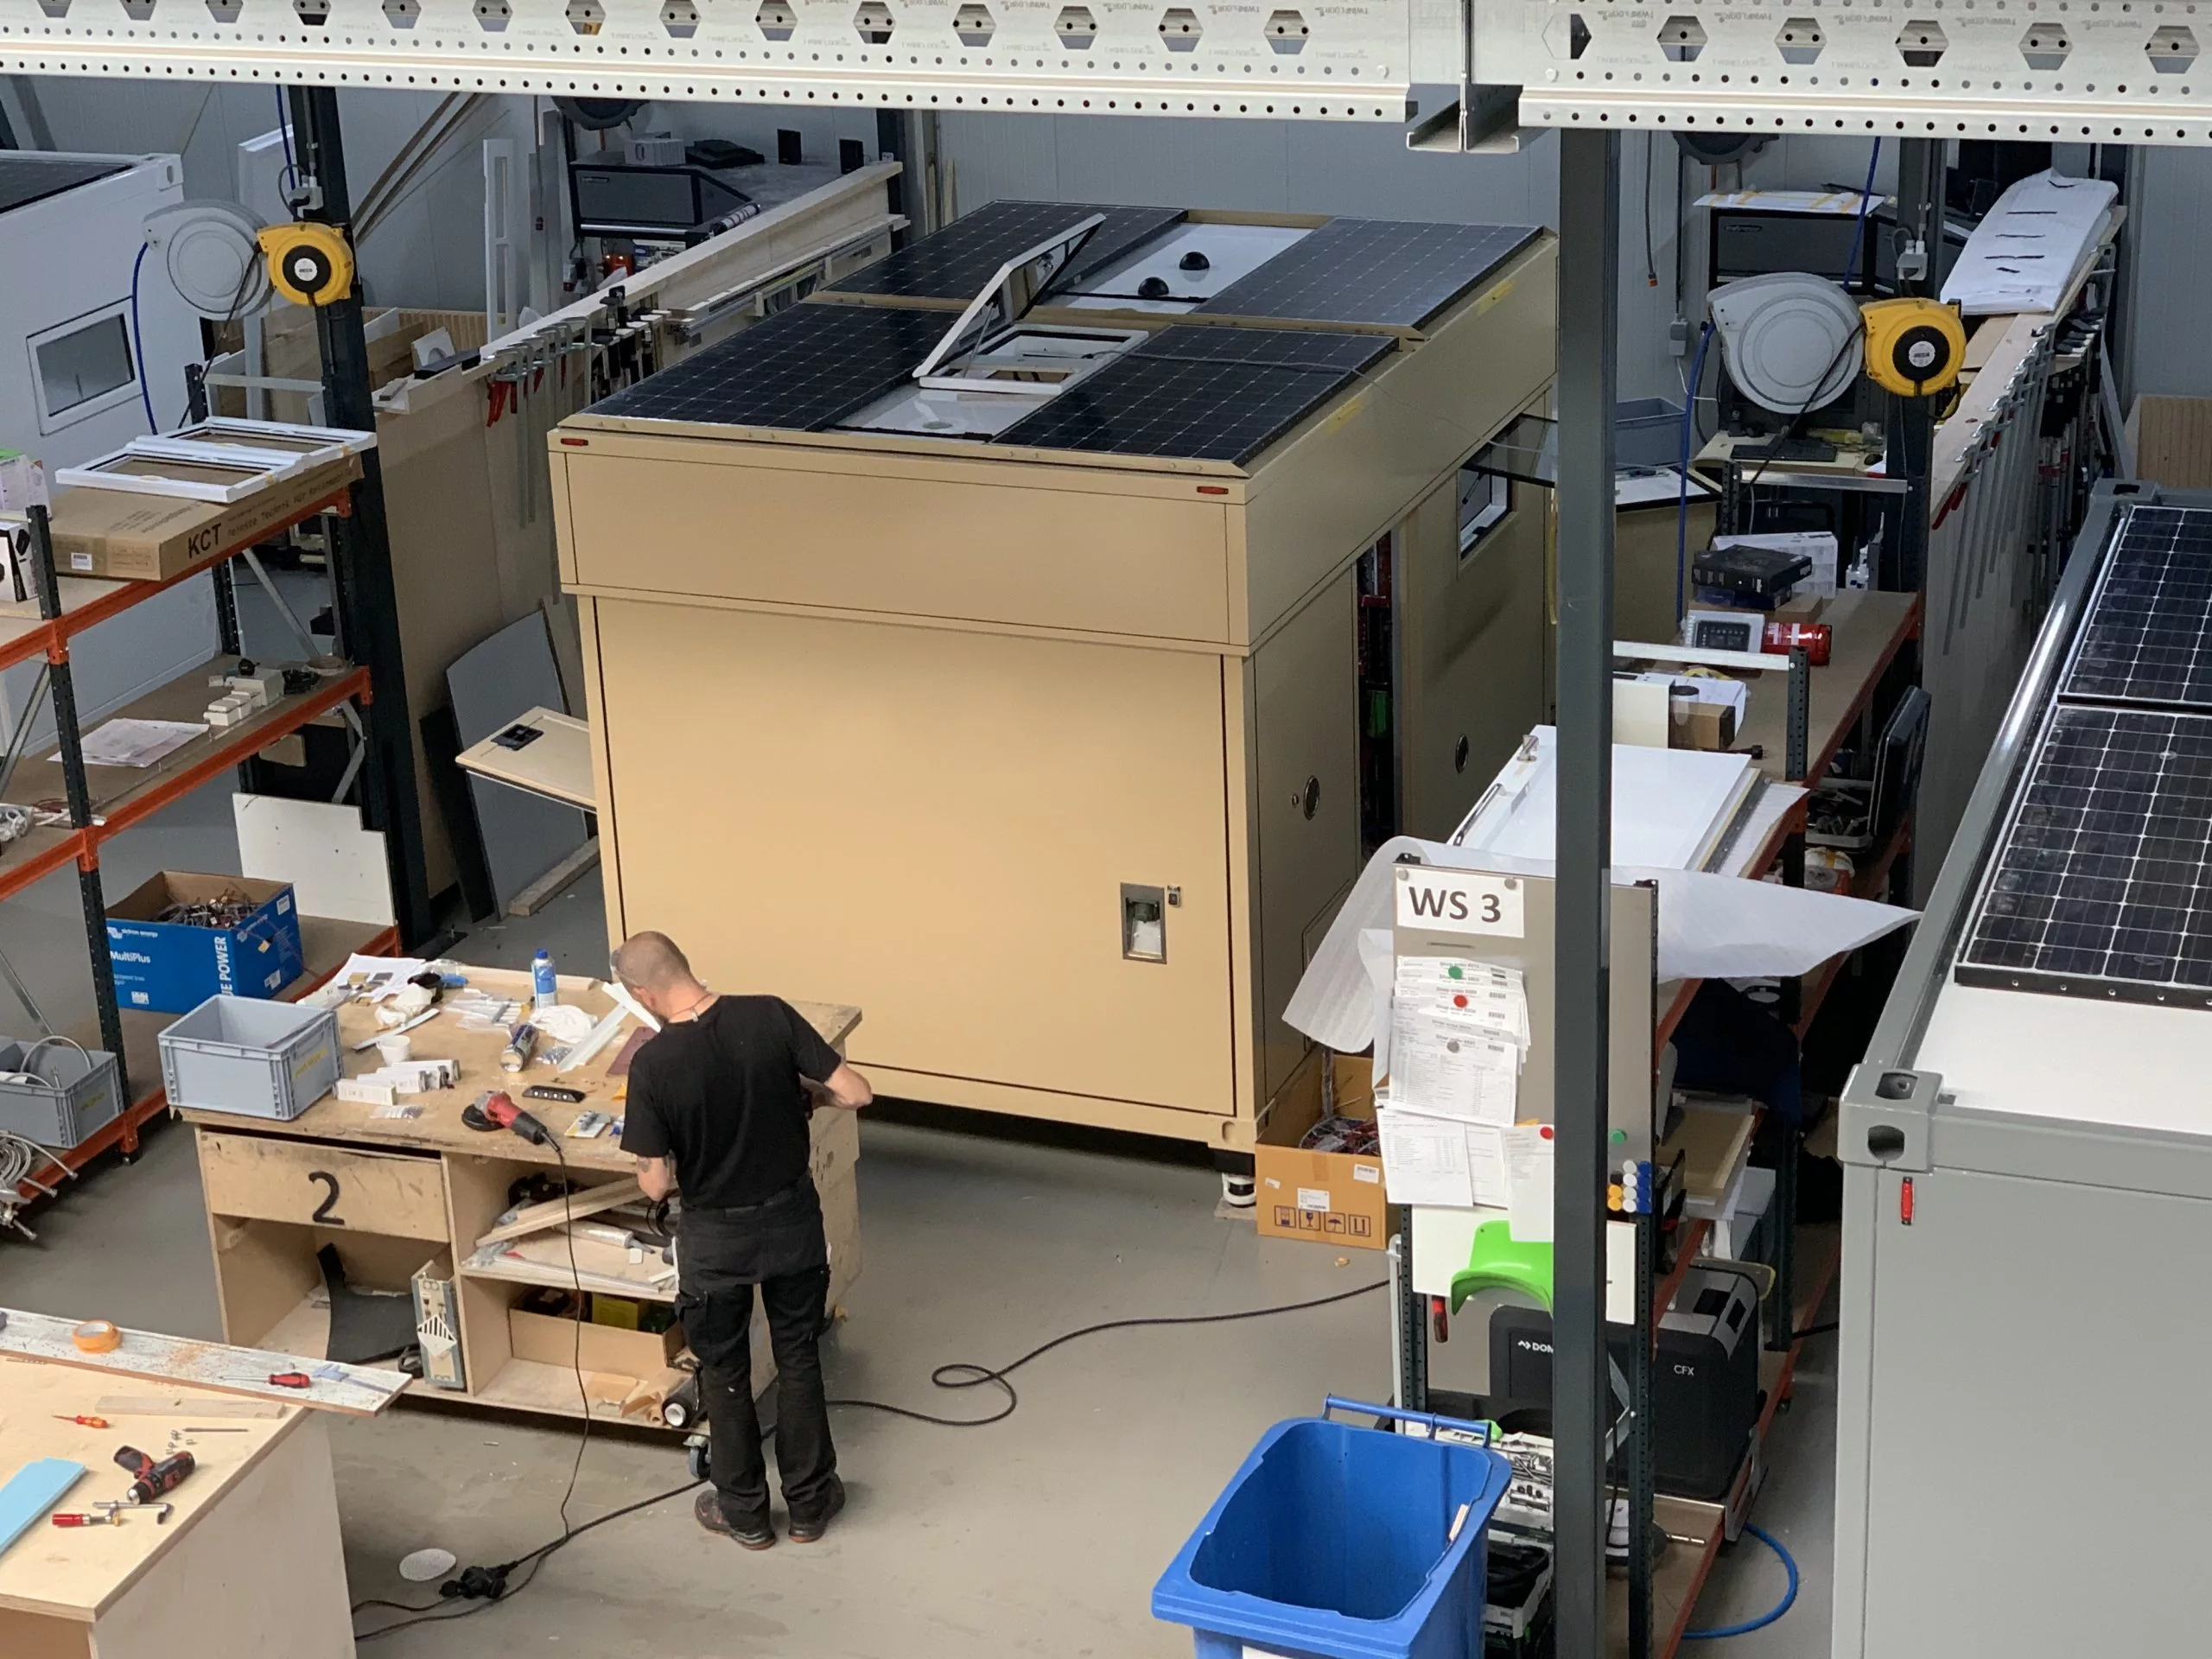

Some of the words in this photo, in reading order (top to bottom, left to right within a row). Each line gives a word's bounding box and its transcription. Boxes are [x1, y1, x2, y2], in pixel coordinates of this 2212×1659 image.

[188, 522, 222, 559] KCT
[1408, 886, 1469, 920] WS
[1481, 893, 1502, 924] 3
[110, 950, 151, 963] MultiPlus
[213, 936, 232, 982] POWER
[308, 1170, 345, 1225] 2
[1673, 1364, 1694, 1377] CFX
